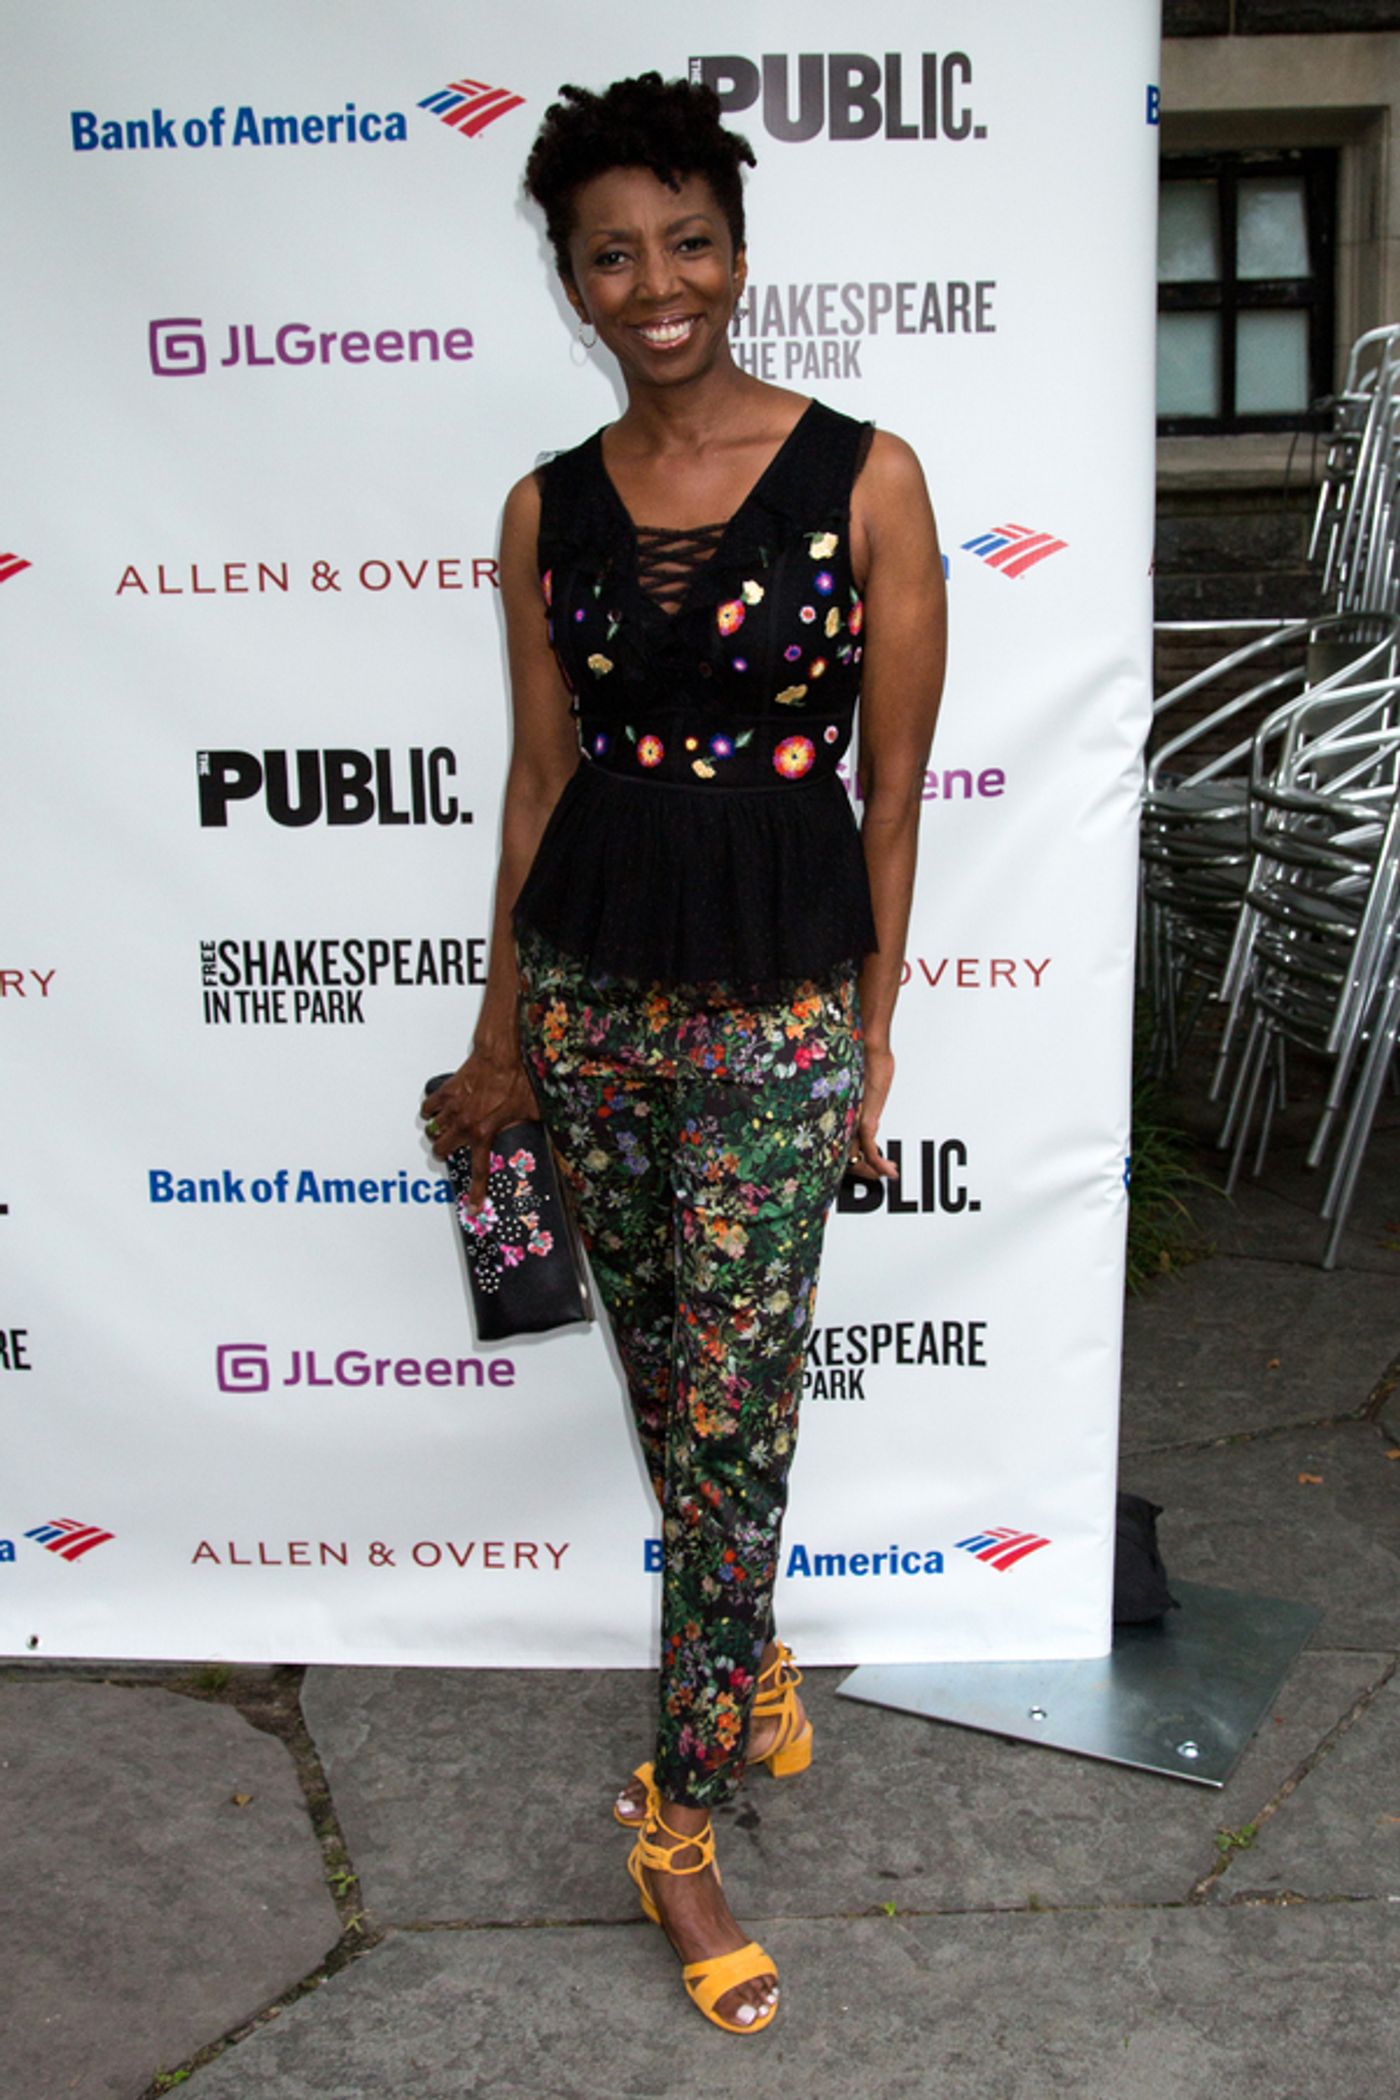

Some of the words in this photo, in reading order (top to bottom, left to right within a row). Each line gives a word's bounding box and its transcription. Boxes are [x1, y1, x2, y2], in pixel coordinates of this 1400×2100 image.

[688, 51, 988, 143] PUBLIC.
[70, 108, 178, 151] Bank
[182, 106, 227, 148] of
[232, 102, 408, 146] America
[221, 323, 475, 367] JLGreene
[731, 340, 777, 381] HE
[785, 339, 862, 380] PARK
[116, 562, 289, 595] ALLEN
[311, 560, 342, 592] &
[359, 557, 499, 591] OVER
[196, 746, 474, 828] PUBLIC.
[200, 940, 217, 986] FREE
[217, 938, 488, 987] SHAKESPEARE
[203, 990, 231, 1024] IN
[234, 990, 288, 1024] THE
[294, 989, 365, 1024] PARK
[148, 1169, 246, 1203] Bank
[250, 1169, 289, 1203] of
[295, 1169, 455, 1204] America
[283, 1350, 516, 1387] JLGreene
[192, 1541, 348, 1566] ALLEN
[368, 1541, 396, 1567] &
[411, 1541, 570, 1570] OVERY
[786, 1544, 944, 1578] America
